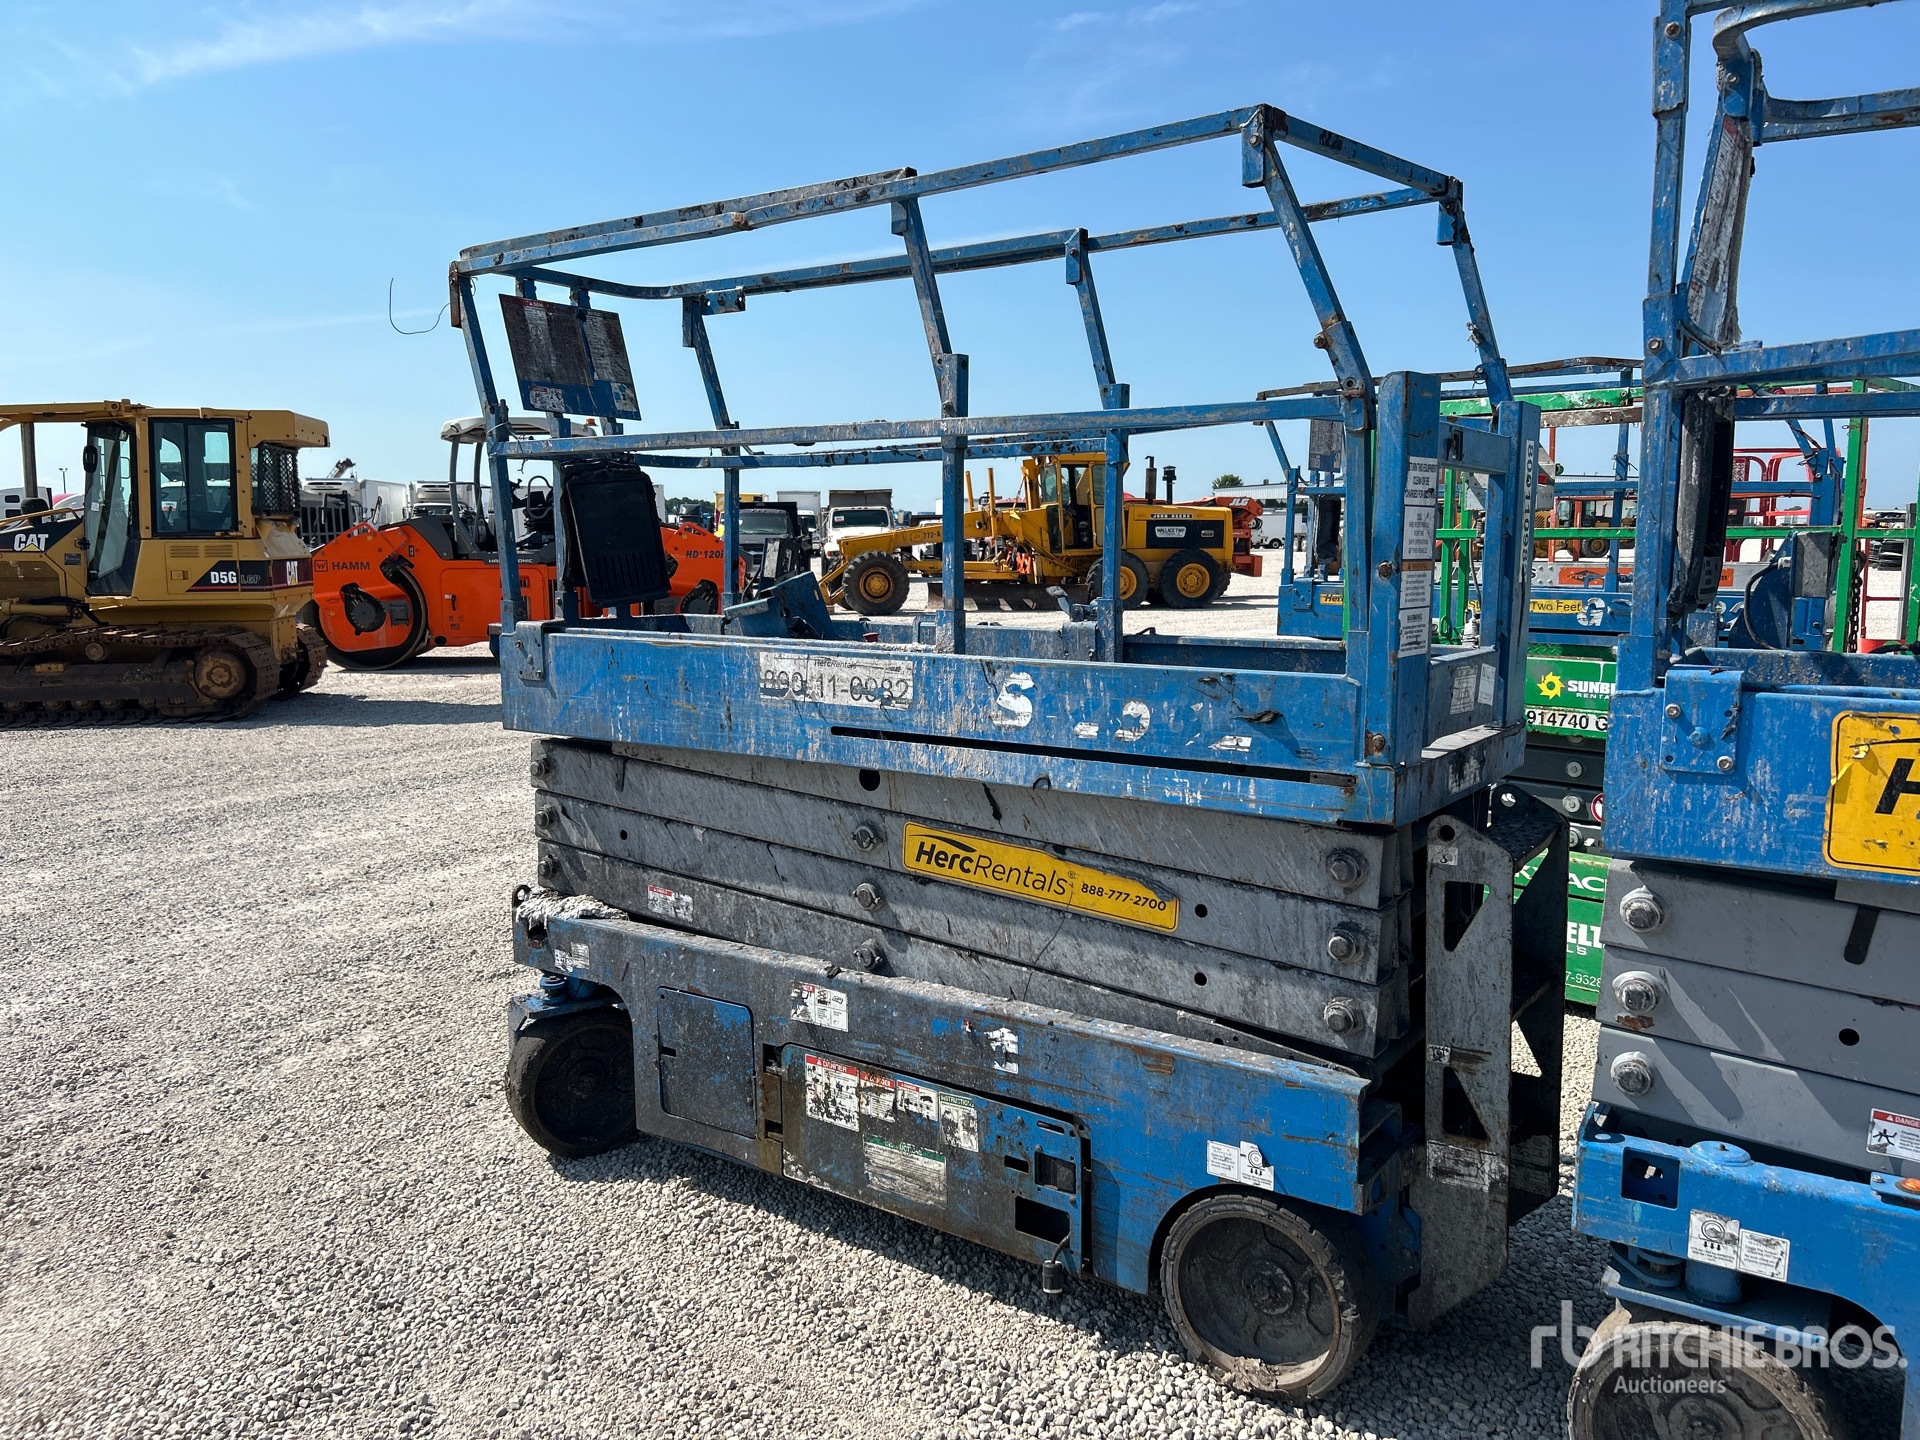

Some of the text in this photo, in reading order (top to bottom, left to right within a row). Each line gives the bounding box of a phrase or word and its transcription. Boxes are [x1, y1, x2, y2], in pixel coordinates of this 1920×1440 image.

[13, 533, 49, 552] CAT
[331, 561, 371, 571] HAMM
[210, 571, 237, 584] D5G
[240, 574, 262, 584] LGP
[286, 560, 299, 586] CAT
[1532, 602, 1553, 611] Two
[1556, 602, 1582, 612] Feet
[1526, 710, 1589, 730] 914740
[915, 841, 1167, 912] HercRentals 888-777-2700
[1895, 1116, 1920, 1128] DANGE
